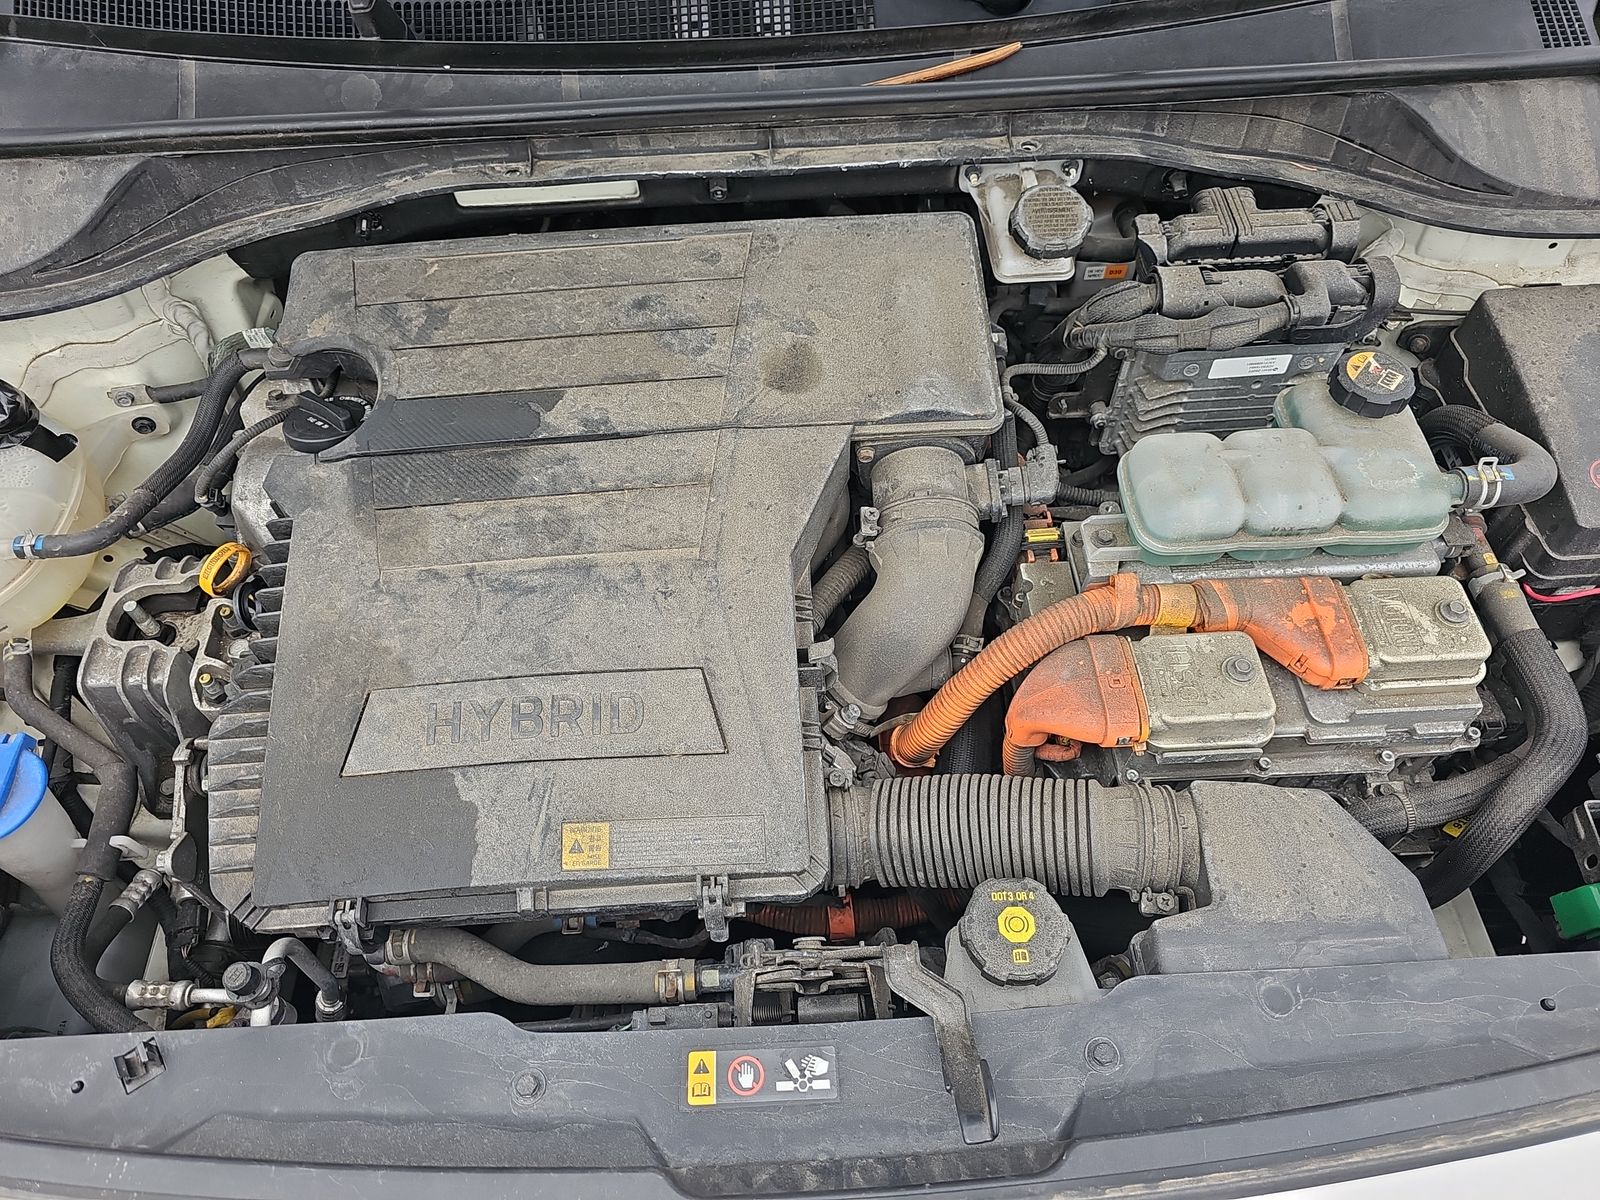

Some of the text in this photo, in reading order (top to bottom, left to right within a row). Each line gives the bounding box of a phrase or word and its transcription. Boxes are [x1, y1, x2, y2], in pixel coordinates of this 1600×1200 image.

[426, 691, 645, 746] HYBRID
[1015, 891, 1028, 901] OR
[1028, 891, 1035, 900] 4
